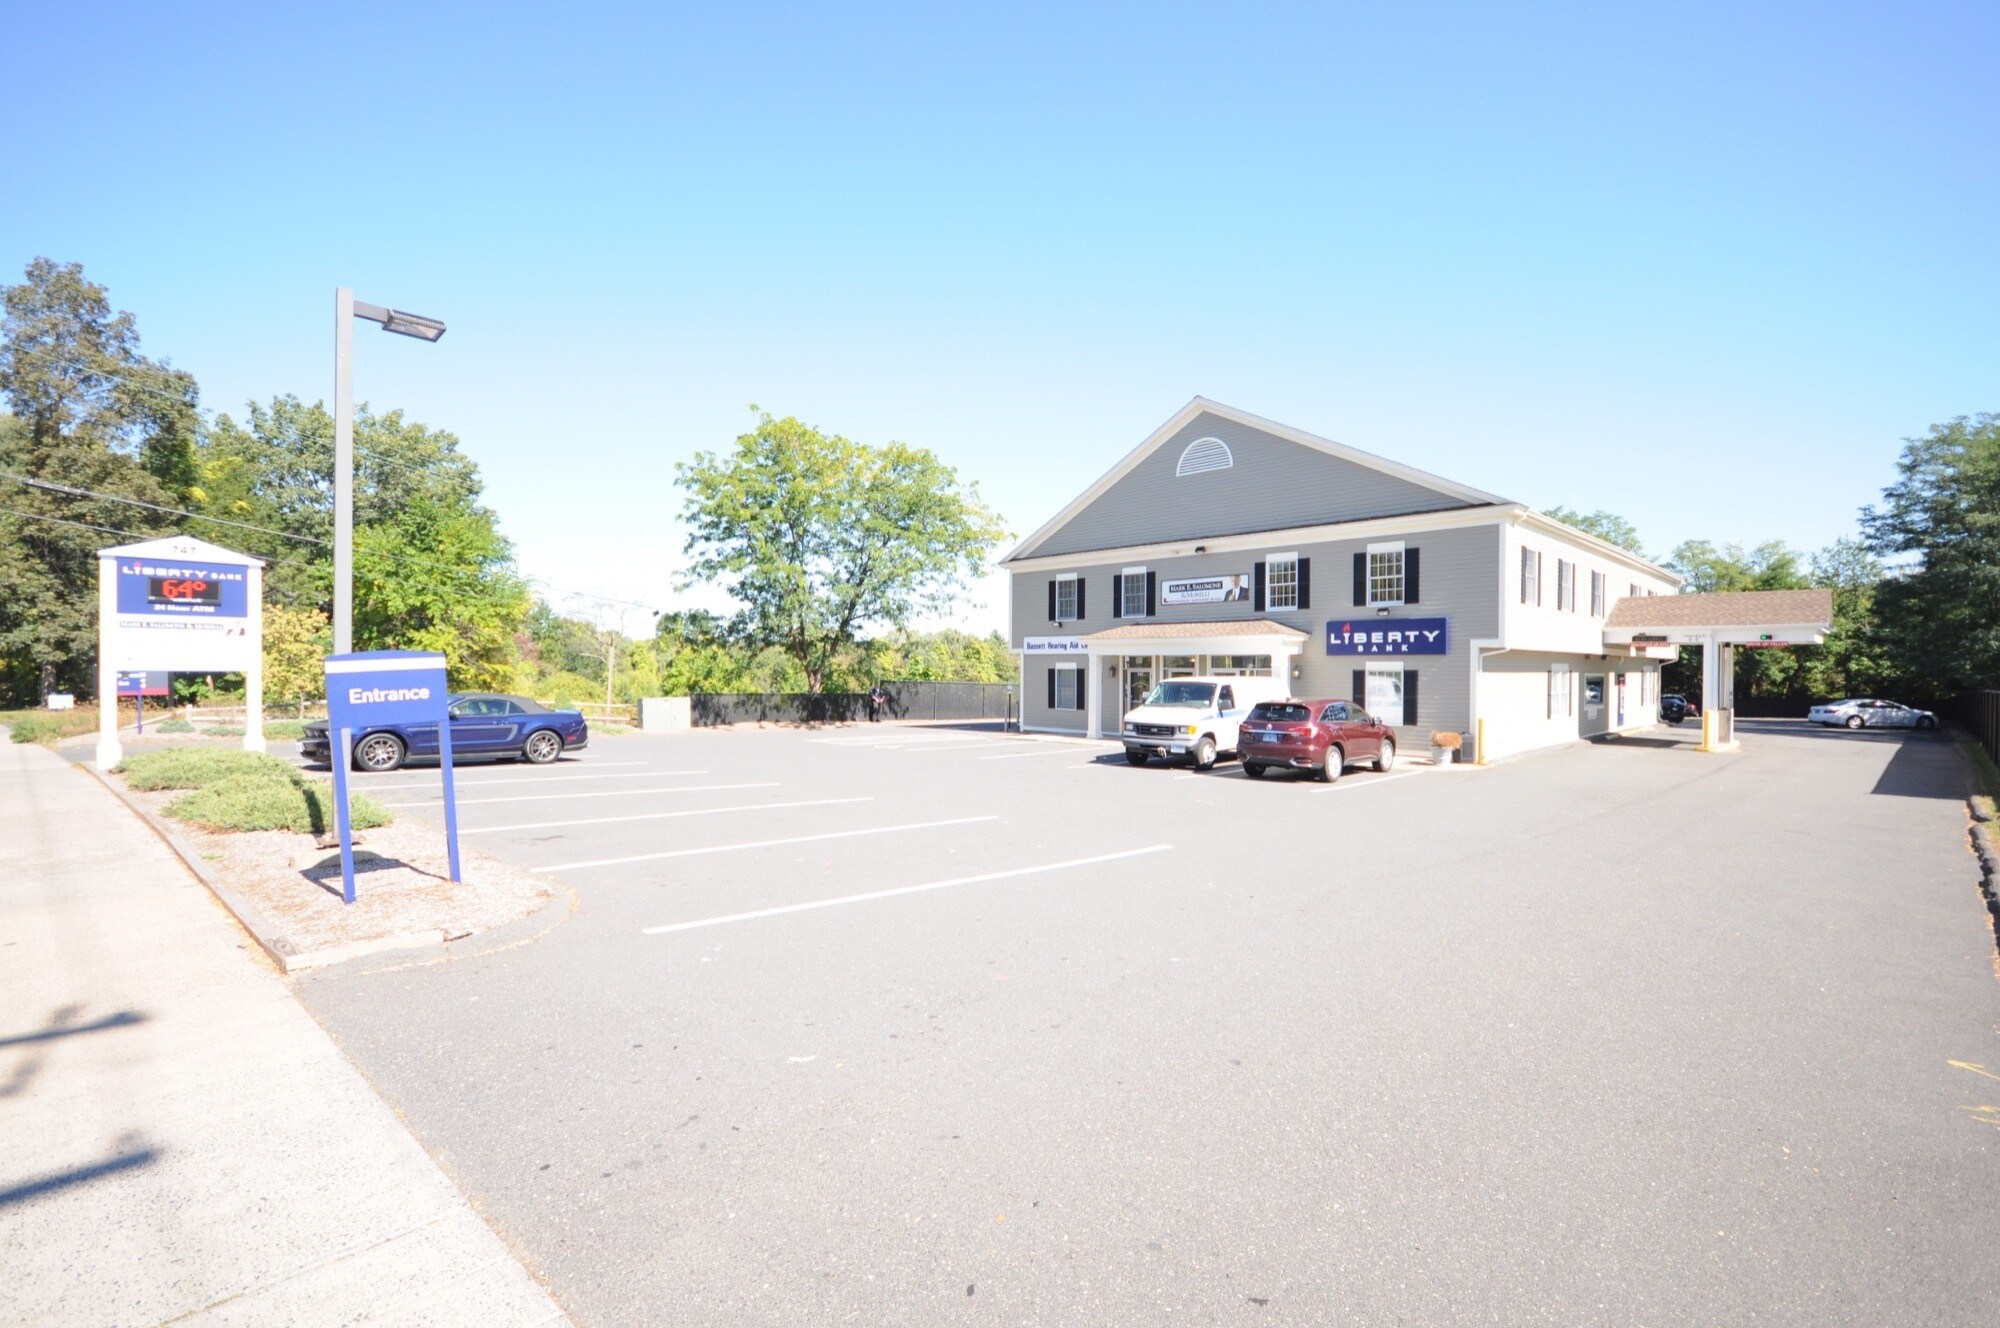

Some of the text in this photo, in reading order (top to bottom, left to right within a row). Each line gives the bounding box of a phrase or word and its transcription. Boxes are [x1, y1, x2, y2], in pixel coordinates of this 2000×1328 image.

[172, 545, 196, 554] 747
[122, 564, 243, 581] LIBERTY BANK
[1170, 584, 1186, 592] MARK
[1192, 582, 1222, 590] SALOMONE
[192, 605, 216, 613] ATM
[1330, 628, 1441, 645] LIBERTY
[1026, 642, 1046, 650] Bassett
[1047, 641, 1068, 651] Hearing
[1069, 641, 1079, 650] Aid
[1357, 644, 1409, 653] BANK
[348, 687, 430, 705] Entrance
